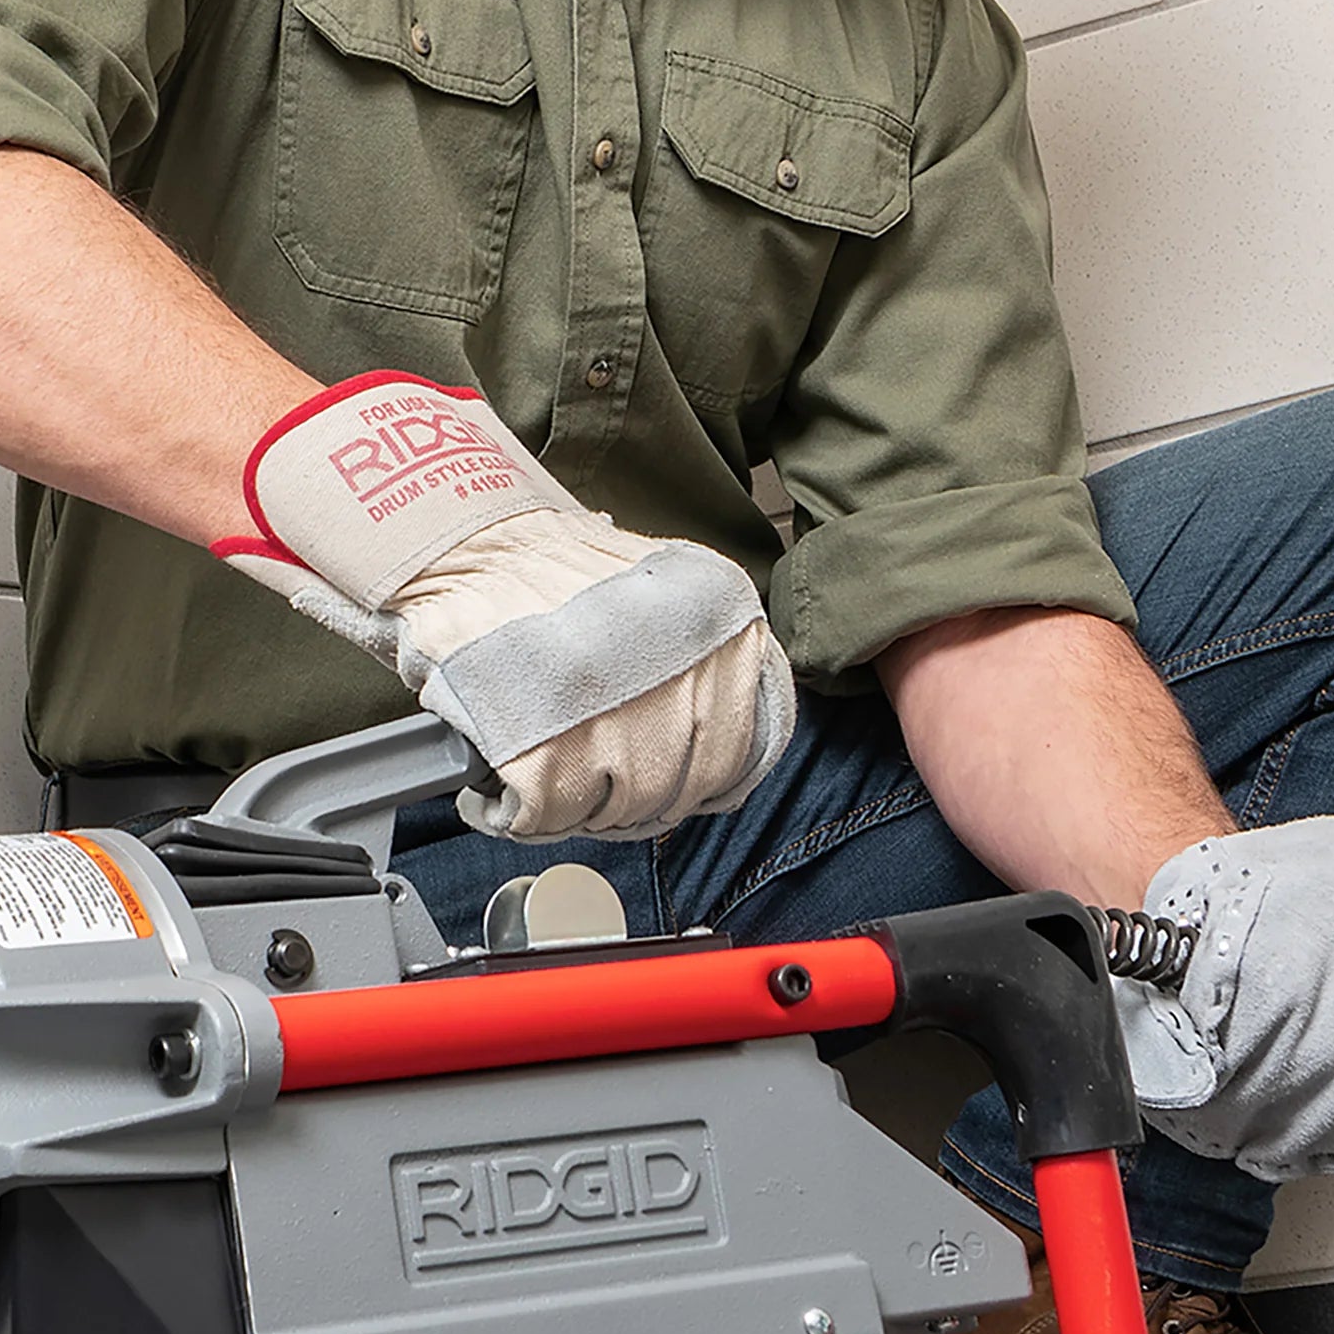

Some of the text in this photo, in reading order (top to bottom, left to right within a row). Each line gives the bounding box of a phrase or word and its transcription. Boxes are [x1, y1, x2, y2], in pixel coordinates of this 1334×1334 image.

[359, 401, 399, 427] FOR
[399, 396, 432, 416] USE
[328, 413, 503, 493] RIDGID
[454, 472, 515, 501] # 41937
[367, 480, 426, 523] DRUM
[423, 456, 481, 489] STYLE
[399, 1139, 701, 1243] RIDGID
